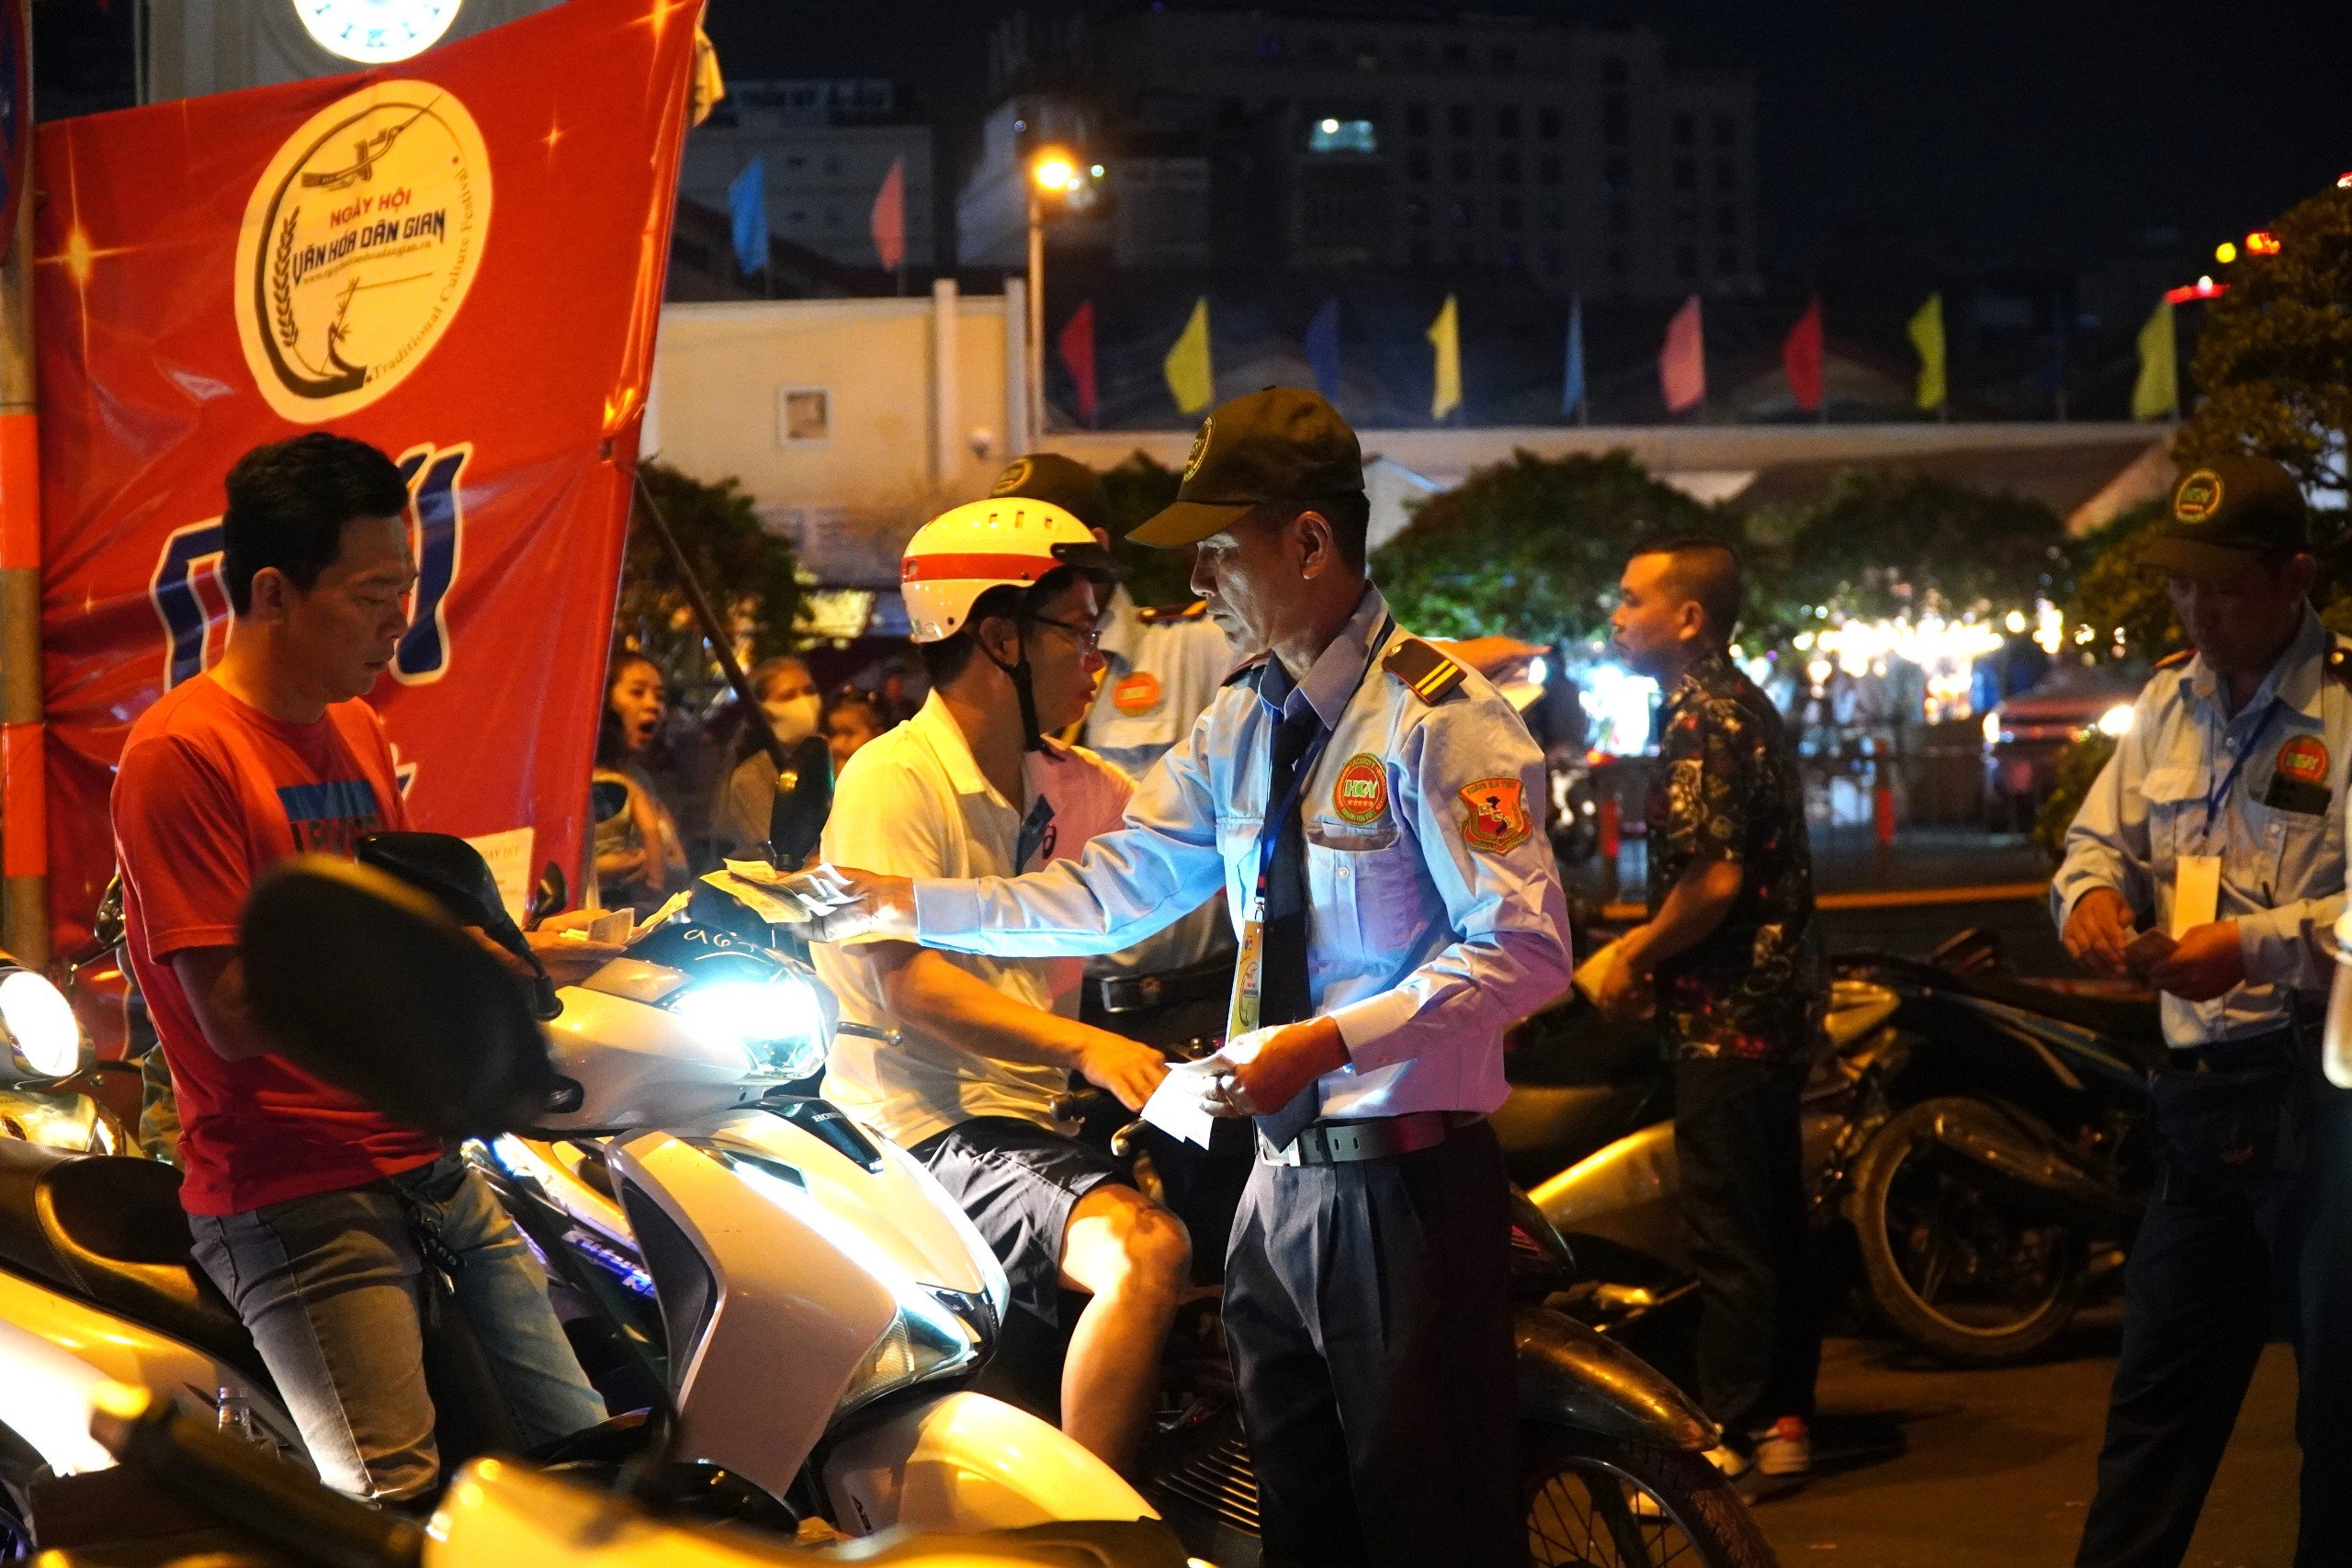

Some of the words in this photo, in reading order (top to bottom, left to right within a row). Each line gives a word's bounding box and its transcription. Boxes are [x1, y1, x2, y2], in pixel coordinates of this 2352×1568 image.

[330, 197, 373, 228] NGÀY
[378, 186, 412, 213] HỘI
[454, 167, 473, 232] Festival
[327, 228, 358, 263] HÓA
[360, 219, 401, 249] DÂN
[402, 207, 447, 244] GIAN
[440, 236, 469, 303] Culture
[371, 304, 443, 380] Traditional
